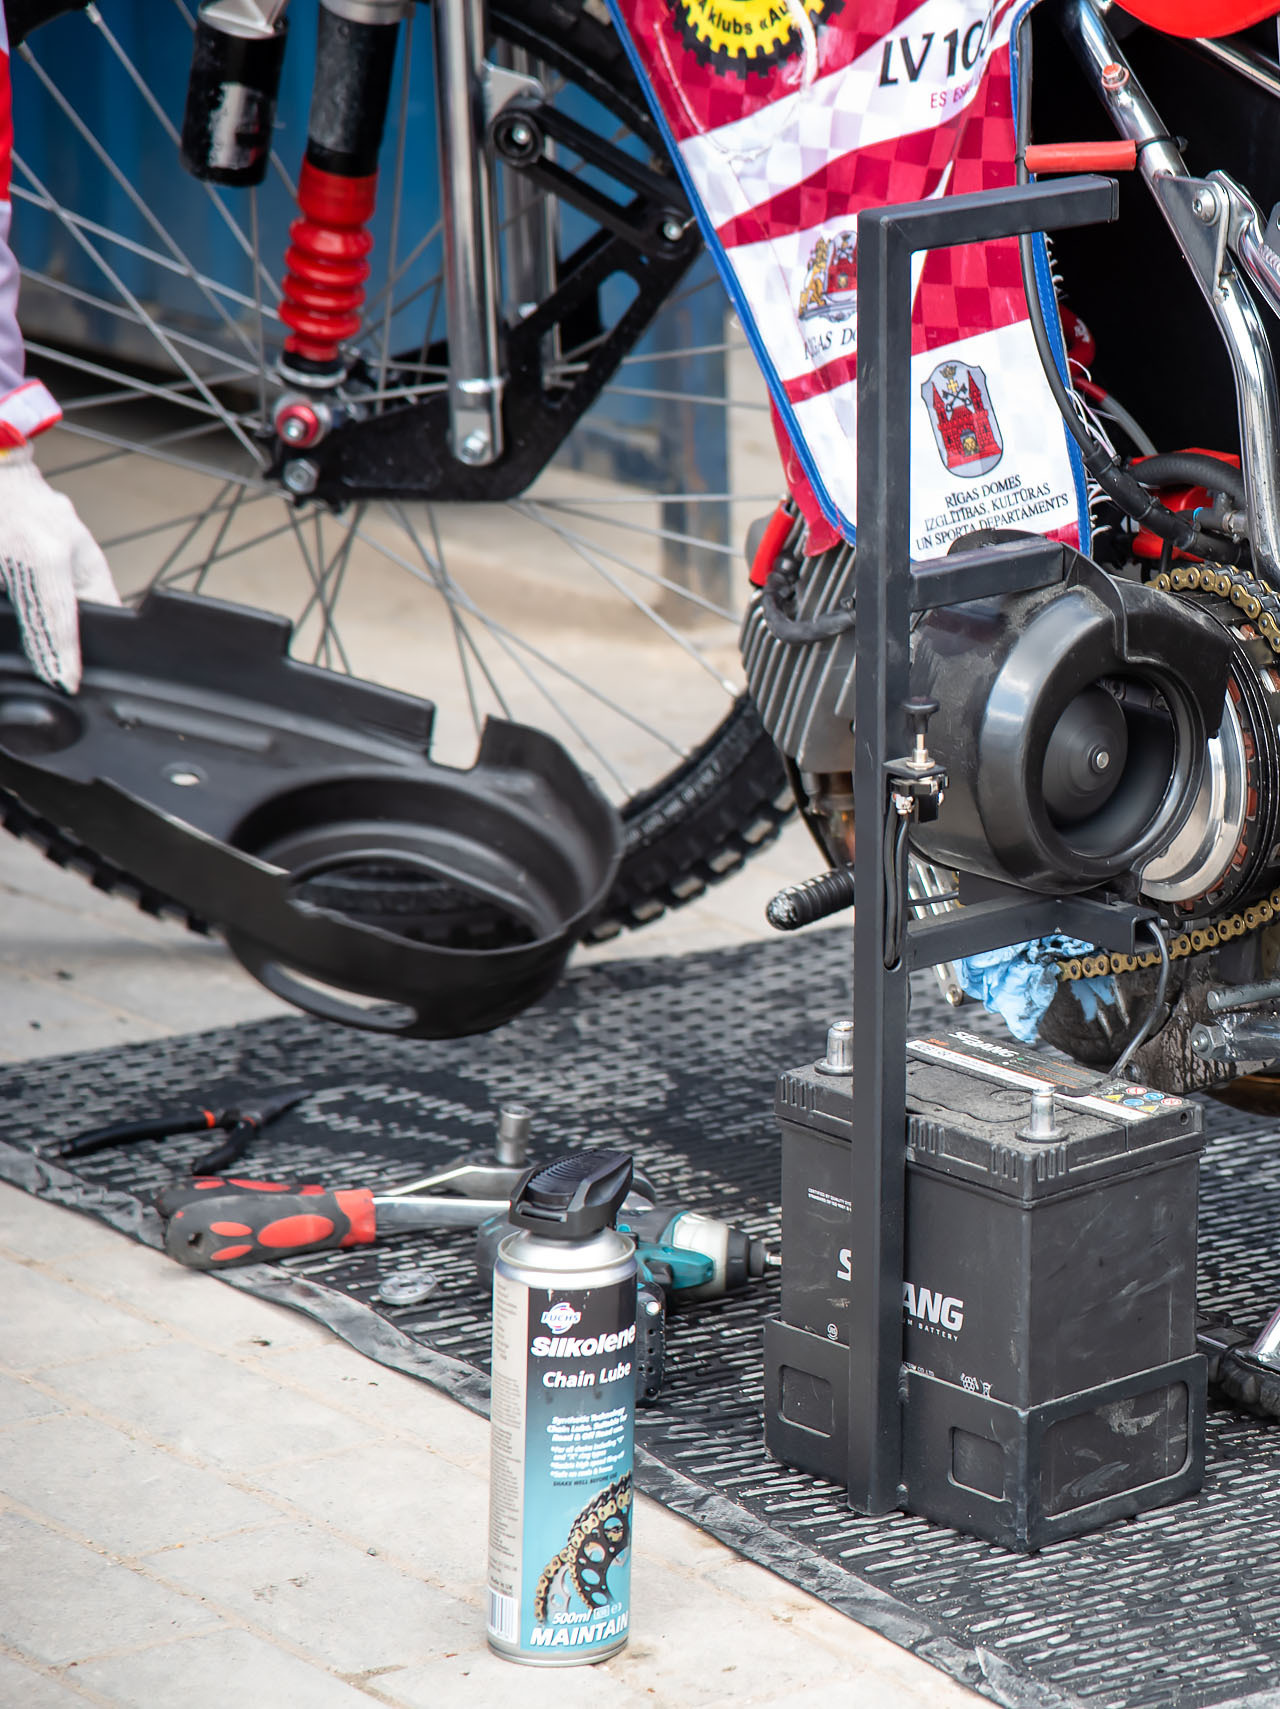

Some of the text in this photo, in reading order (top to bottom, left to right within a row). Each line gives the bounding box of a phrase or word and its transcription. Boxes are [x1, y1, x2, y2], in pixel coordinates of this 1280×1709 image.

[708, 5, 753, 35] klubs
[879, 32, 935, 88] LV
[930, 91, 948, 109] ES
[944, 474, 1022, 508] RĪGAS DOMES
[991, 482, 1051, 512] KULTŪRAS
[916, 535, 933, 551] UN
[935, 523, 976, 545] SPORTA
[543, 1312, 581, 1323] FUCHS
[918, 1321, 959, 1342] BATTERY
[530, 1324, 637, 1357] Silkolene
[542, 1361, 632, 1388] Chain Lube
[529, 1611, 630, 1647] MAINTAIN
[551, 1610, 592, 1625] 500ml
